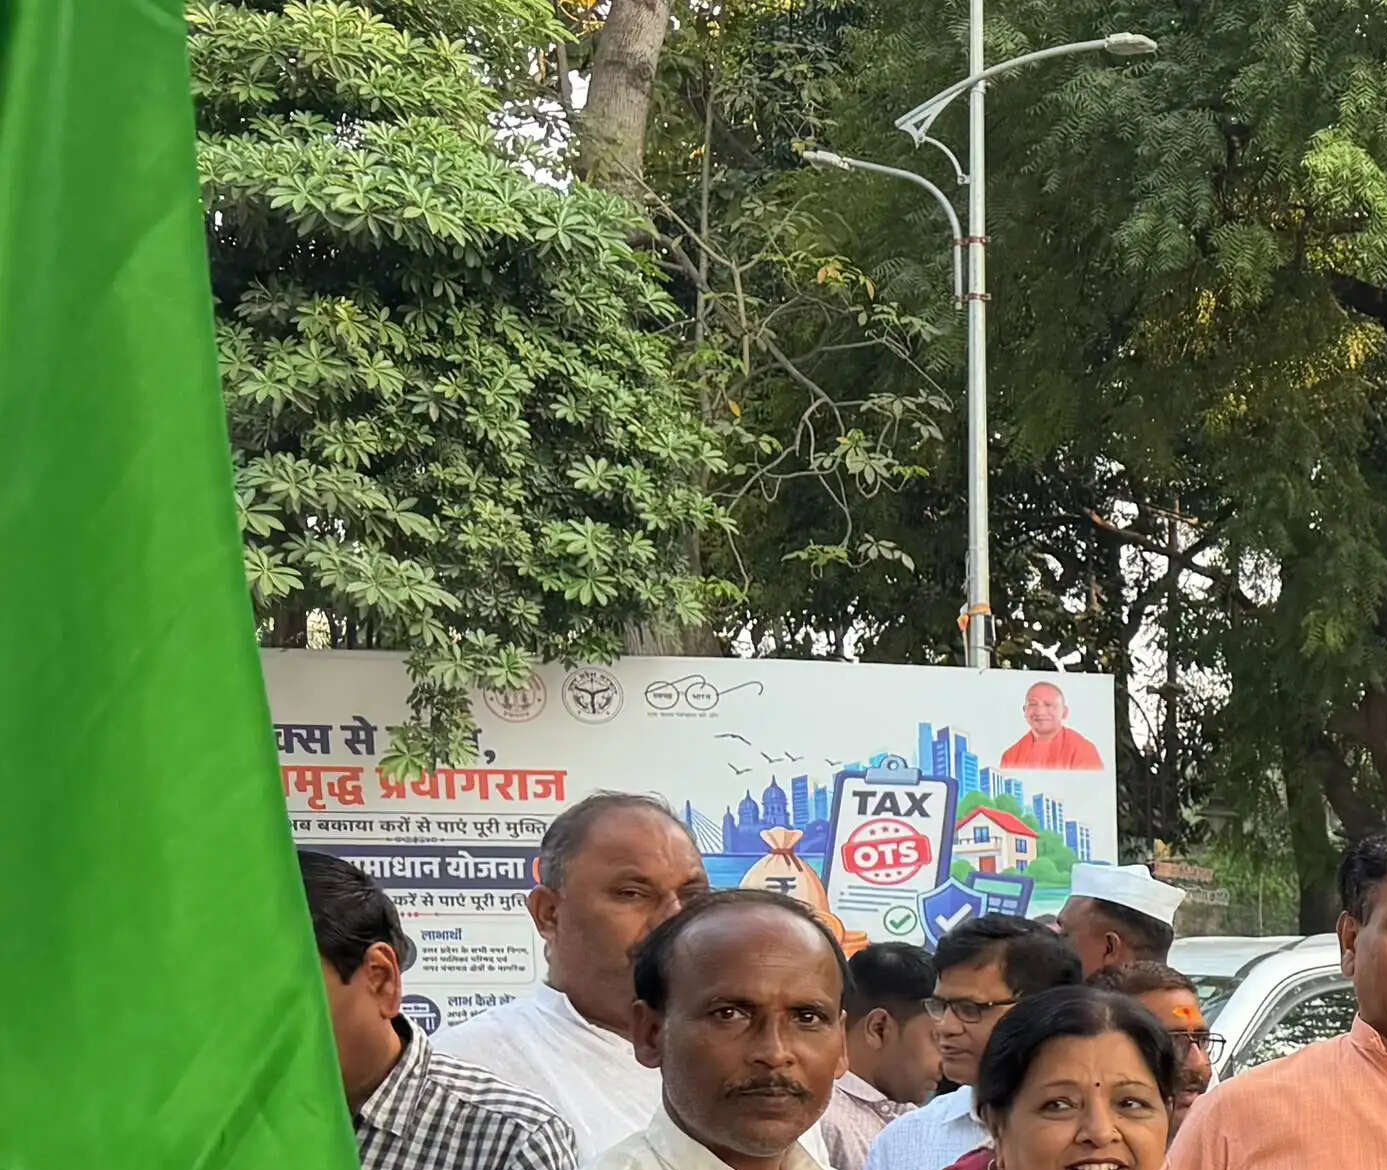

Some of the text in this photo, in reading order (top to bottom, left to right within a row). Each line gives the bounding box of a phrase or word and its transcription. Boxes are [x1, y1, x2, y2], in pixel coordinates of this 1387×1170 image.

[274, 724, 333, 754] क्स
[340, 716, 378, 755] से
[375, 767, 568, 802] प्रयागराज
[852, 790, 933, 818] TAX
[316, 819, 374, 832] बकाया
[379, 816, 411, 833] करों
[415, 816, 431, 833] से
[437, 817, 467, 834] पाएं
[473, 817, 500, 838] पूरी
[340, 850, 526, 879] माधान योजना
[853, 840, 919, 868] OTS
[421, 893, 434, 907] से
[439, 893, 466, 907] पाएं
[470, 893, 495, 911] पूरी
